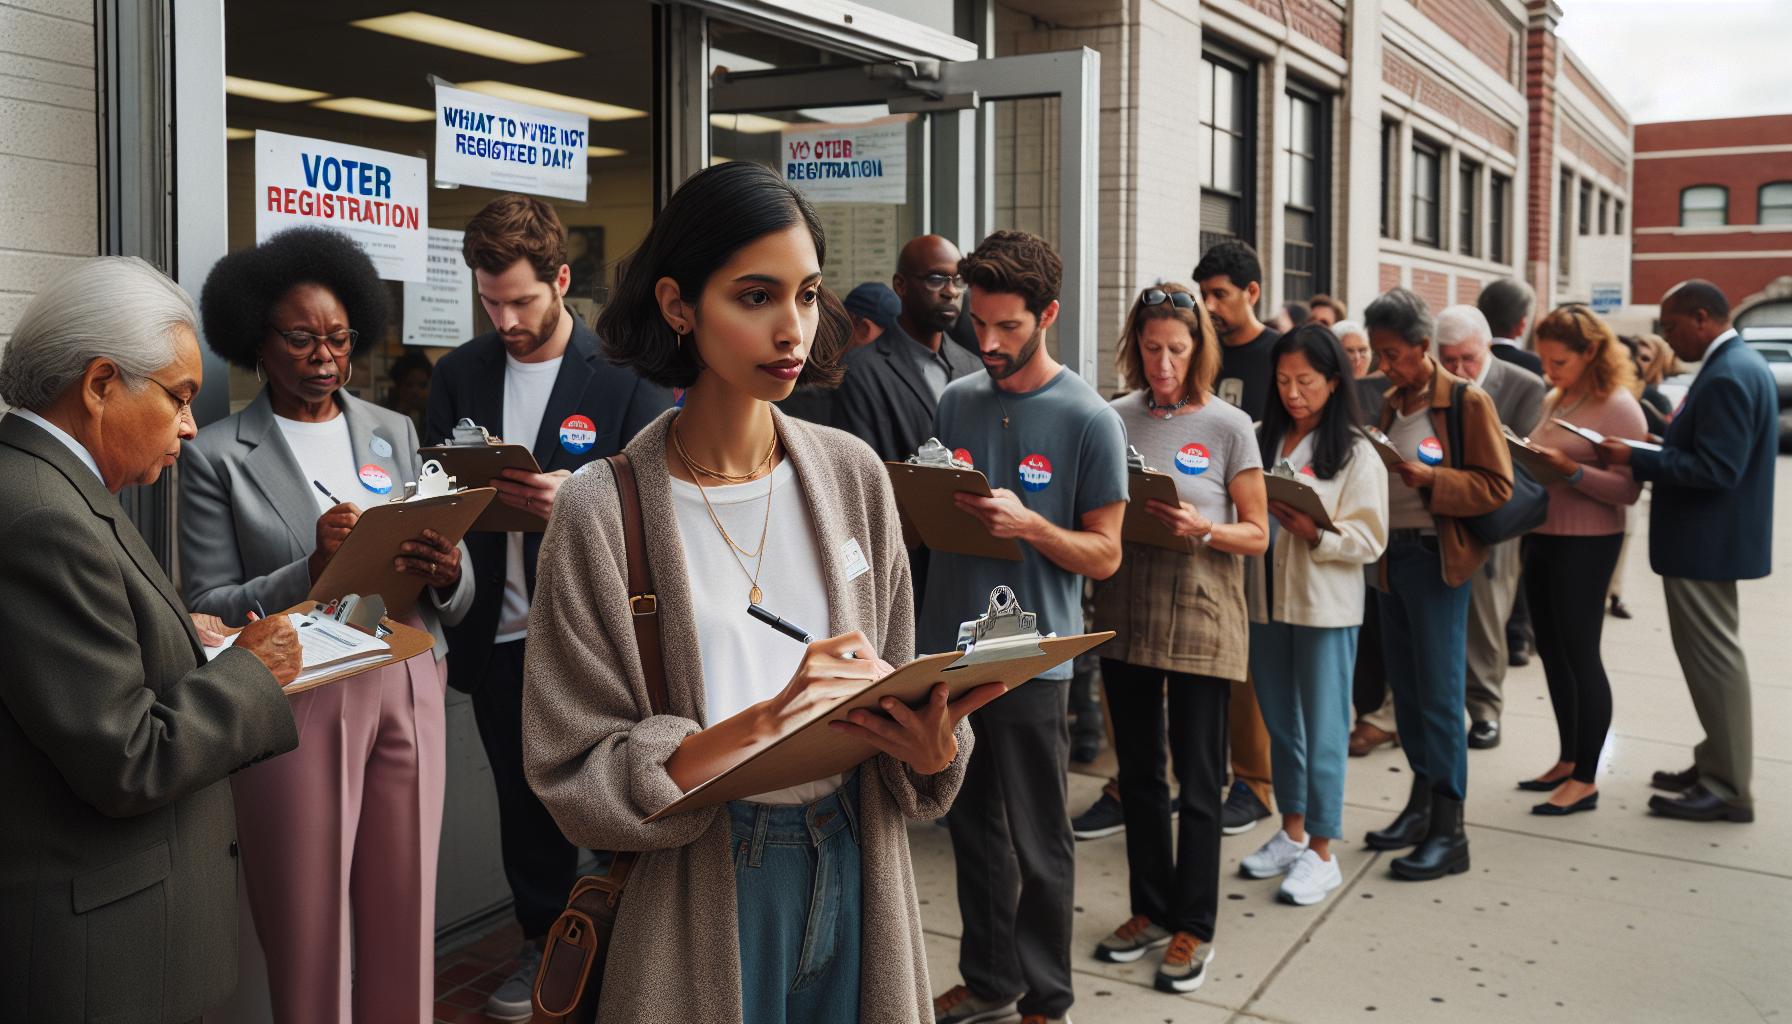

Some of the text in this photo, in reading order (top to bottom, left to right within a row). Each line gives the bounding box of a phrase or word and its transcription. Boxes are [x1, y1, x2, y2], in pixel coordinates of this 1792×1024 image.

[499, 117, 517, 138] TO
[301, 153, 392, 199] VOTER
[267, 186, 419, 230] REGISTRATION
